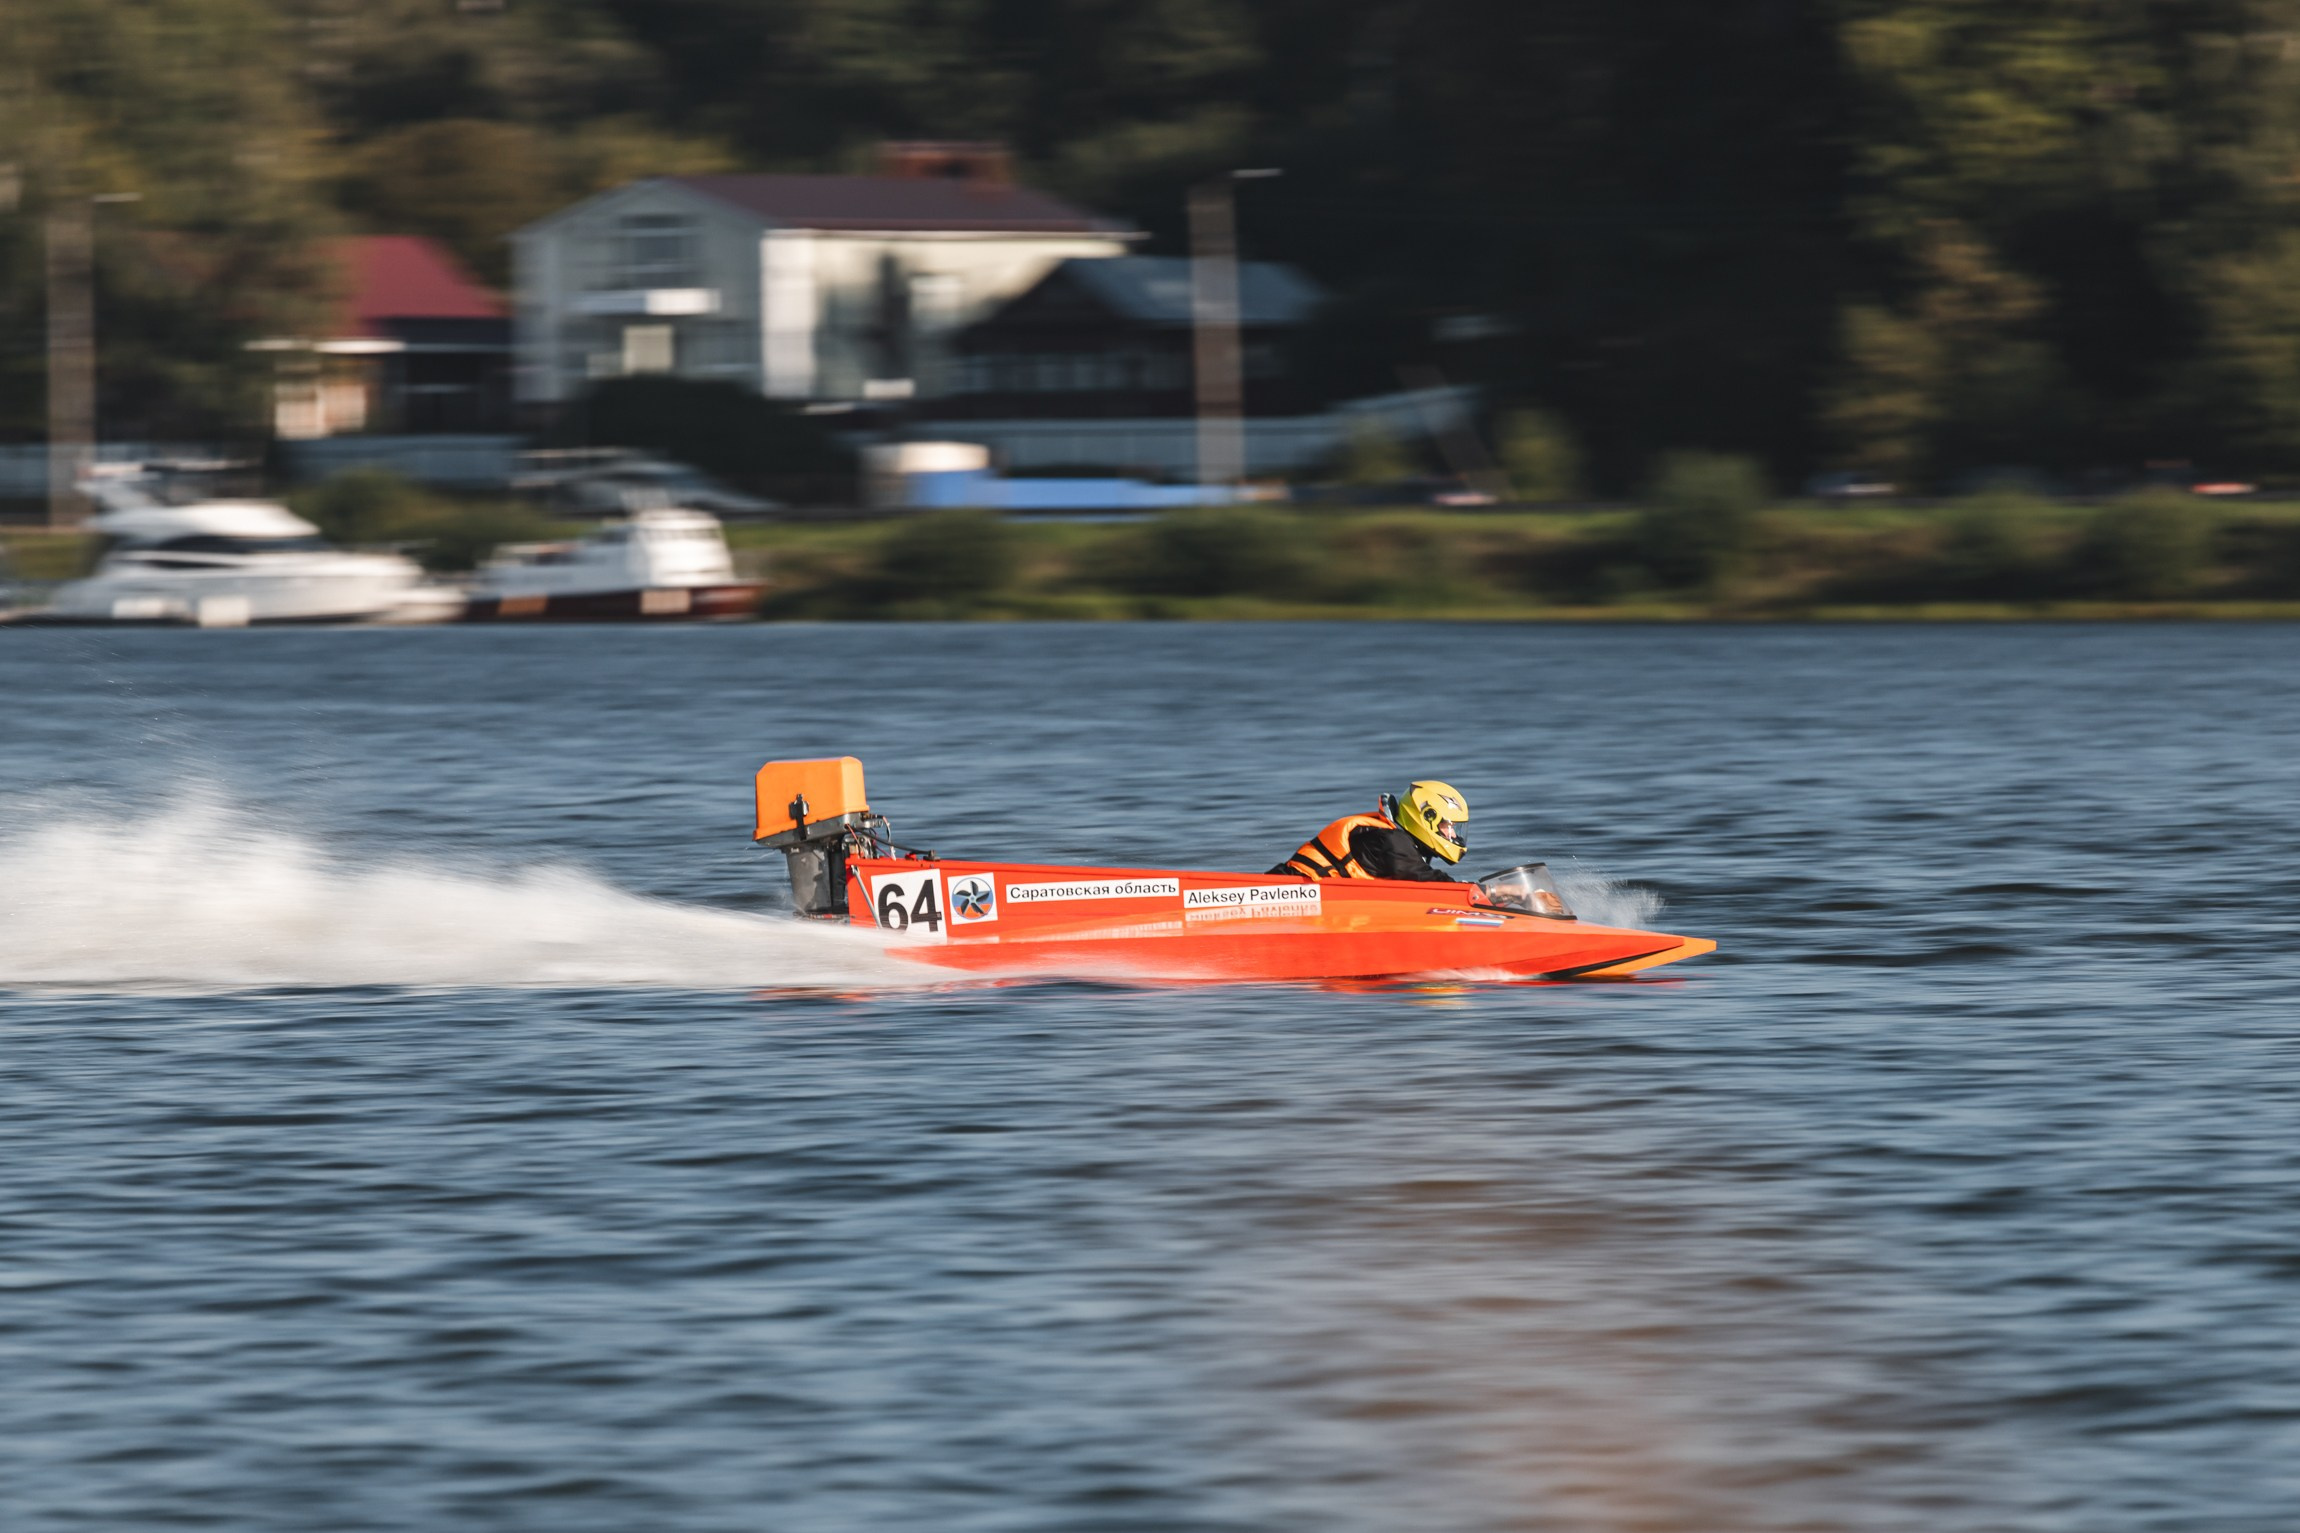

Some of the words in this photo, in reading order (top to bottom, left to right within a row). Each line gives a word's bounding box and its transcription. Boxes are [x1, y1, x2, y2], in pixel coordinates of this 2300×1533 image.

[1010, 885, 1110, 901] Саратовская
[1115, 882, 1176, 894] область
[1188, 891, 1245, 905] Aleksey
[1250, 886, 1317, 901] Pavlenko
[878, 879, 942, 934] 64
